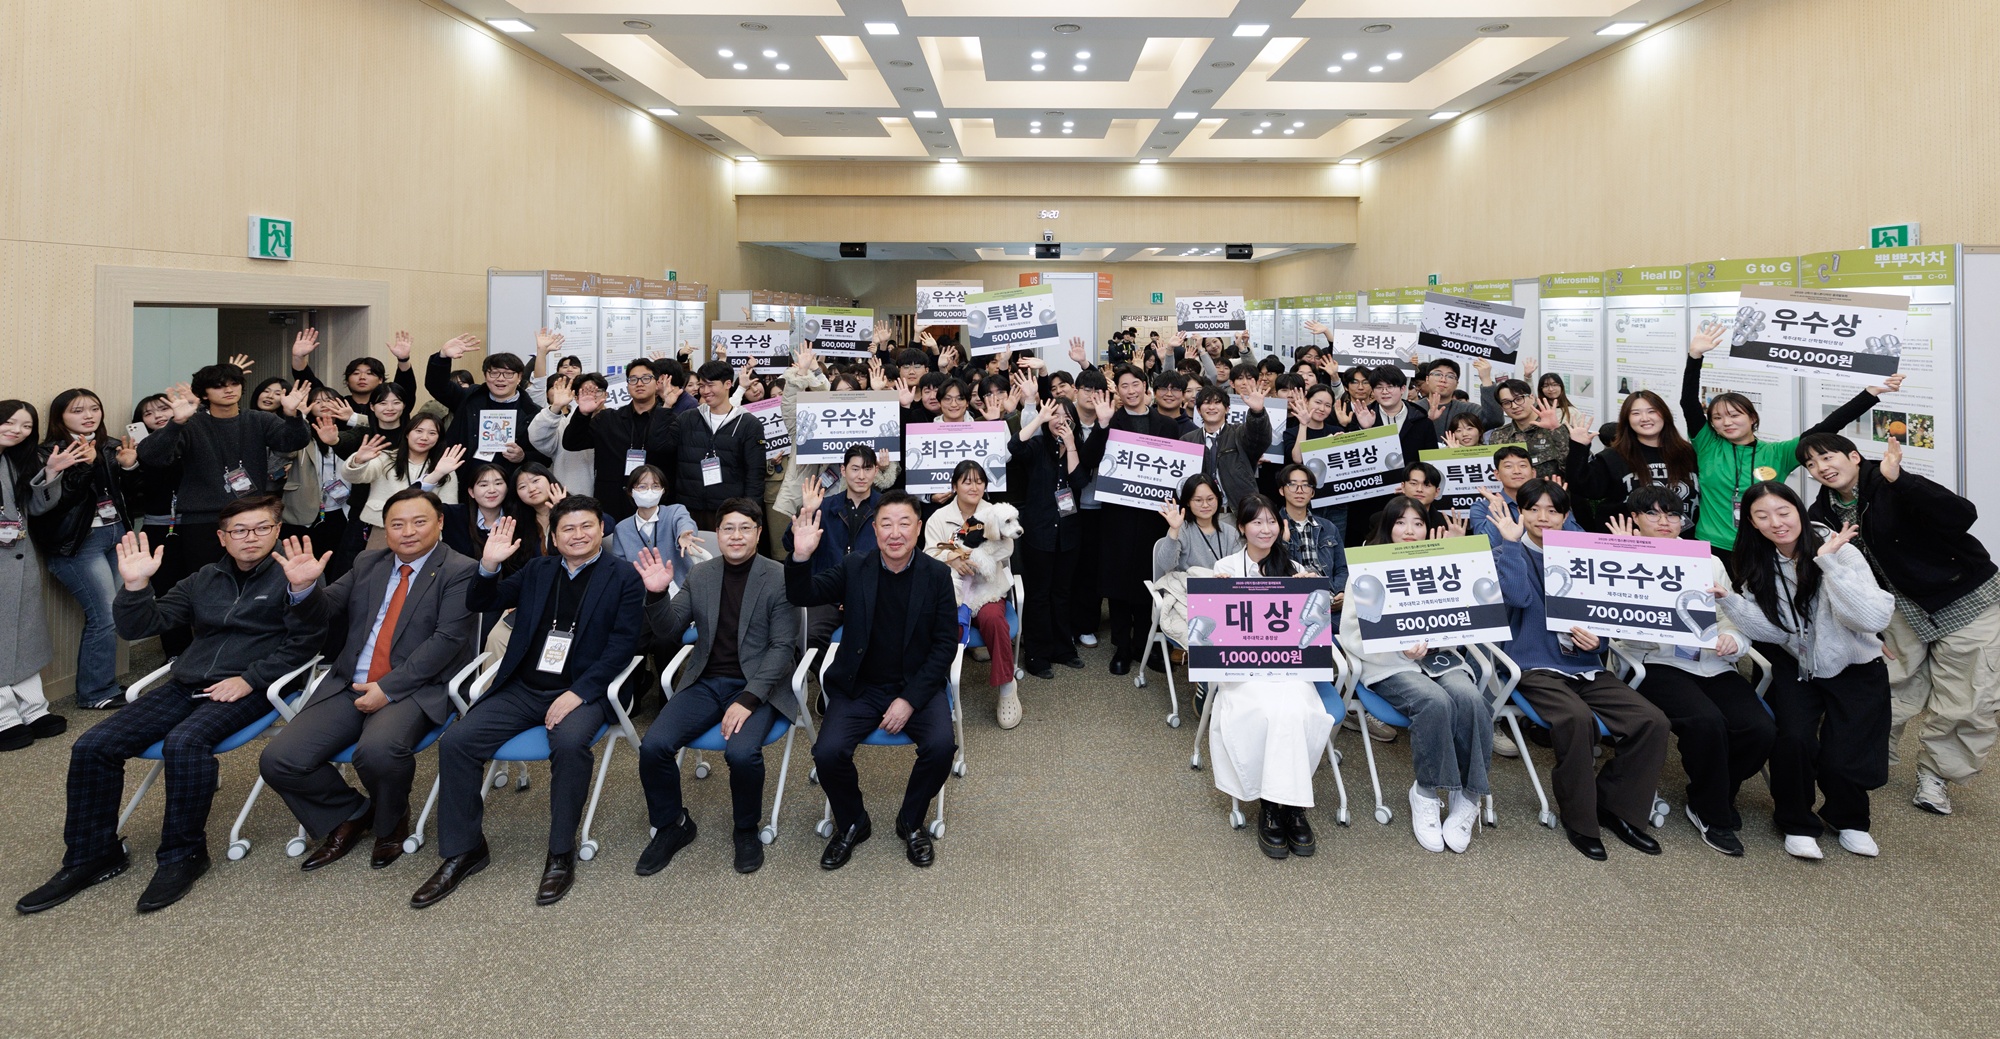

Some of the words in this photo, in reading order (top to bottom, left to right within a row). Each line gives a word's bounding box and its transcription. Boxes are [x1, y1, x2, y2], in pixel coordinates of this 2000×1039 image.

[1746, 264, 1756, 273] G
[1760, 264, 1776, 273] to
[1780, 262, 1792, 272] G
[1874, 251, 1947, 268] 뿌뿌자차
[1554, 276, 1599, 284] Microsmile
[1641, 272, 1666, 280] Heal
[1669, 270, 1682, 279] ID
[932, 290, 968, 302] 우수상
[987, 301, 1034, 322] 특별상
[1192, 301, 1228, 314] 우수상
[821, 319, 856, 332] 특별상
[1444, 311, 1497, 336] 장려상
[1771, 309, 1862, 337] 우수상
[730, 334, 771, 349] 우수상
[992, 329, 1037, 342] 500,000원
[1352, 335, 1396, 350] 장려상
[822, 341, 856, 349] 500,000원
[1441, 340, 1492, 357] 300,000원
[1352, 357, 1394, 366] 300,000원
[1769, 347, 1853, 368] 500,000원
[605, 387, 632, 404] 려상
[483, 420, 510, 431] CAP
[758, 413, 783, 427] 우수
[821, 408, 875, 428] 우수상
[482, 428, 512, 443] STONE
[766, 436, 792, 449] 0,000
[921, 439, 989, 458] 최우수상
[1116, 450, 1186, 478] 최우수상
[1327, 445, 1378, 470] 특별상
[931, 472, 952, 481] 700,
[1446, 463, 1496, 483] 특별상
[1122, 483, 1173, 500] 700,000원
[1333, 475, 1383, 492] 500,000원
[1386, 563, 1461, 596] 특별상
[1570, 558, 1685, 592] 최우수상
[1226, 601, 1253, 632] 대
[1264, 601, 1292, 632] 상
[1396, 611, 1471, 631] 500,000원
[1587, 604, 1673, 626] 700,000원
[1219, 650, 1302, 666] 1,000,000원
